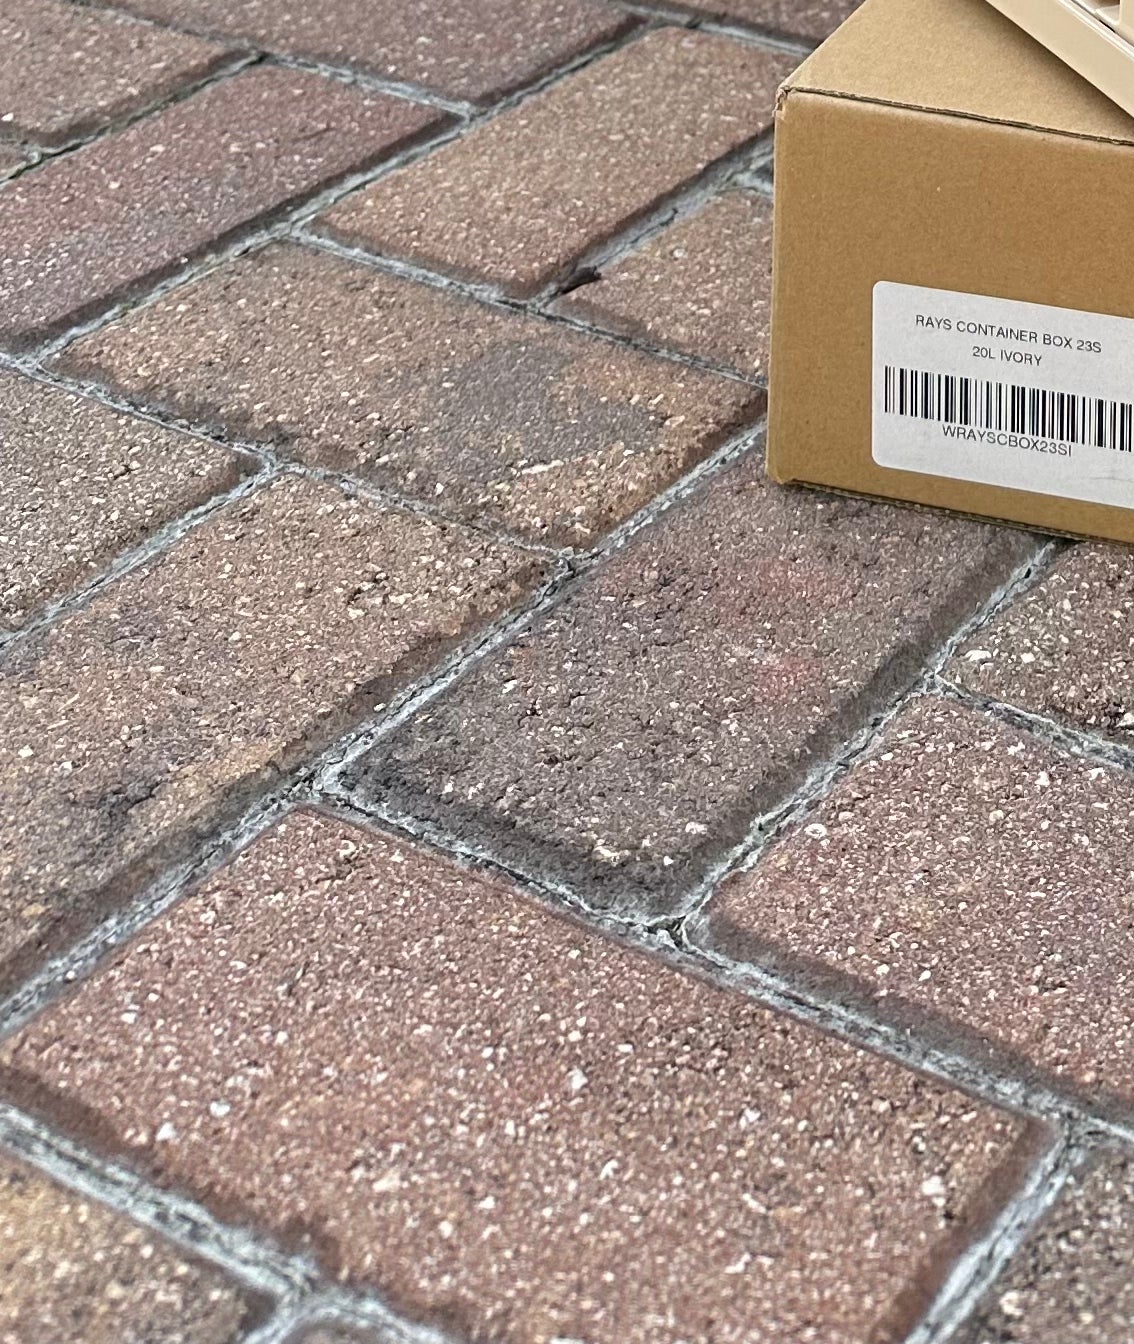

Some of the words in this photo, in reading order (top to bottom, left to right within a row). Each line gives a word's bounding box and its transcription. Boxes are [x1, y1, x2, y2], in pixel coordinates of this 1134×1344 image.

[915, 314, 952, 331] RAYS
[956, 320, 1038, 344] CONTAINER
[1043, 334, 1073, 349] BOX
[1076, 339, 1102, 353] 23S
[972, 346, 996, 360] 20L
[1000, 349, 1042, 367] IVORY
[942, 424, 1072, 457] WRAYSCBOX23SI
